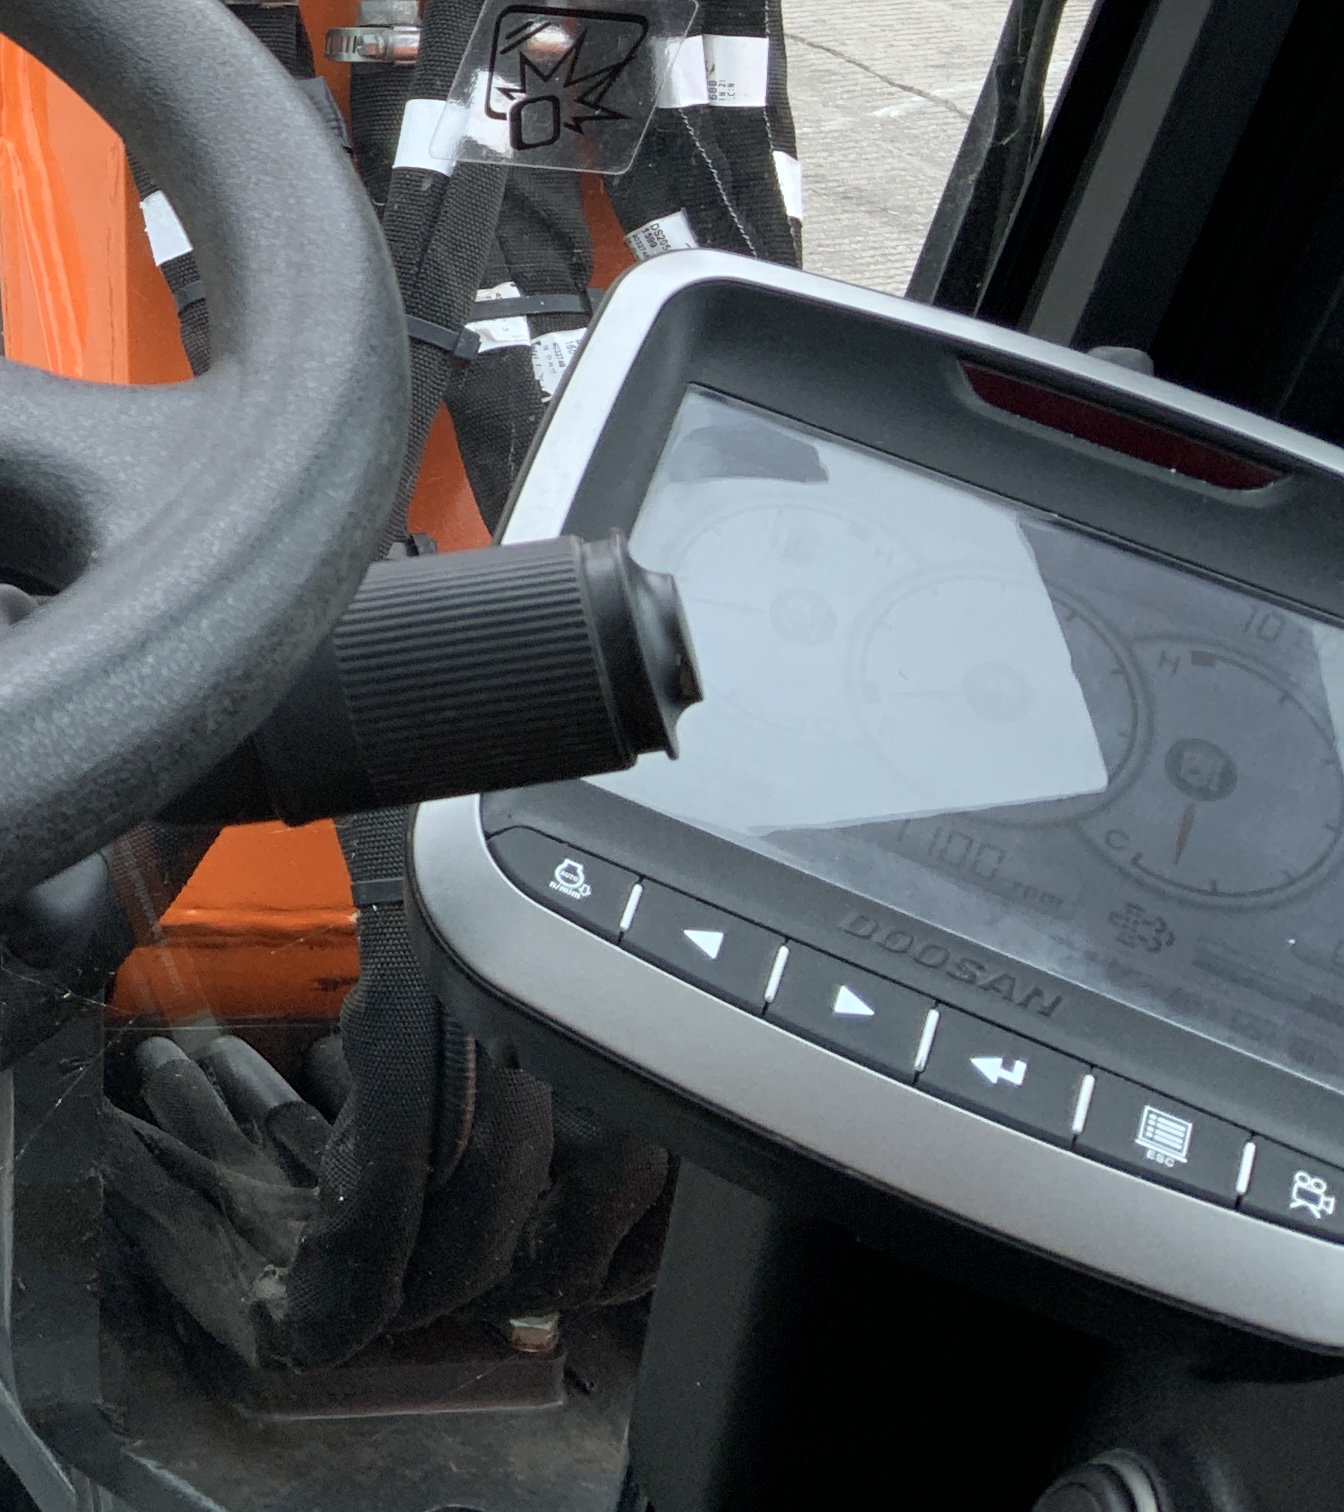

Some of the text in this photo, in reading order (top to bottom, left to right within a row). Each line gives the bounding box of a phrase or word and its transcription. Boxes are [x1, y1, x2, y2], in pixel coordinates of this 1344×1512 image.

[1158, 651, 1181, 676] H
[1104, 827, 1130, 850] C
[560, 870, 579, 882] AUTO
[549, 880, 581, 899] n/min
[838, 912, 1062, 1017] DOOSAN
[1147, 1149, 1175, 1168] ESC
